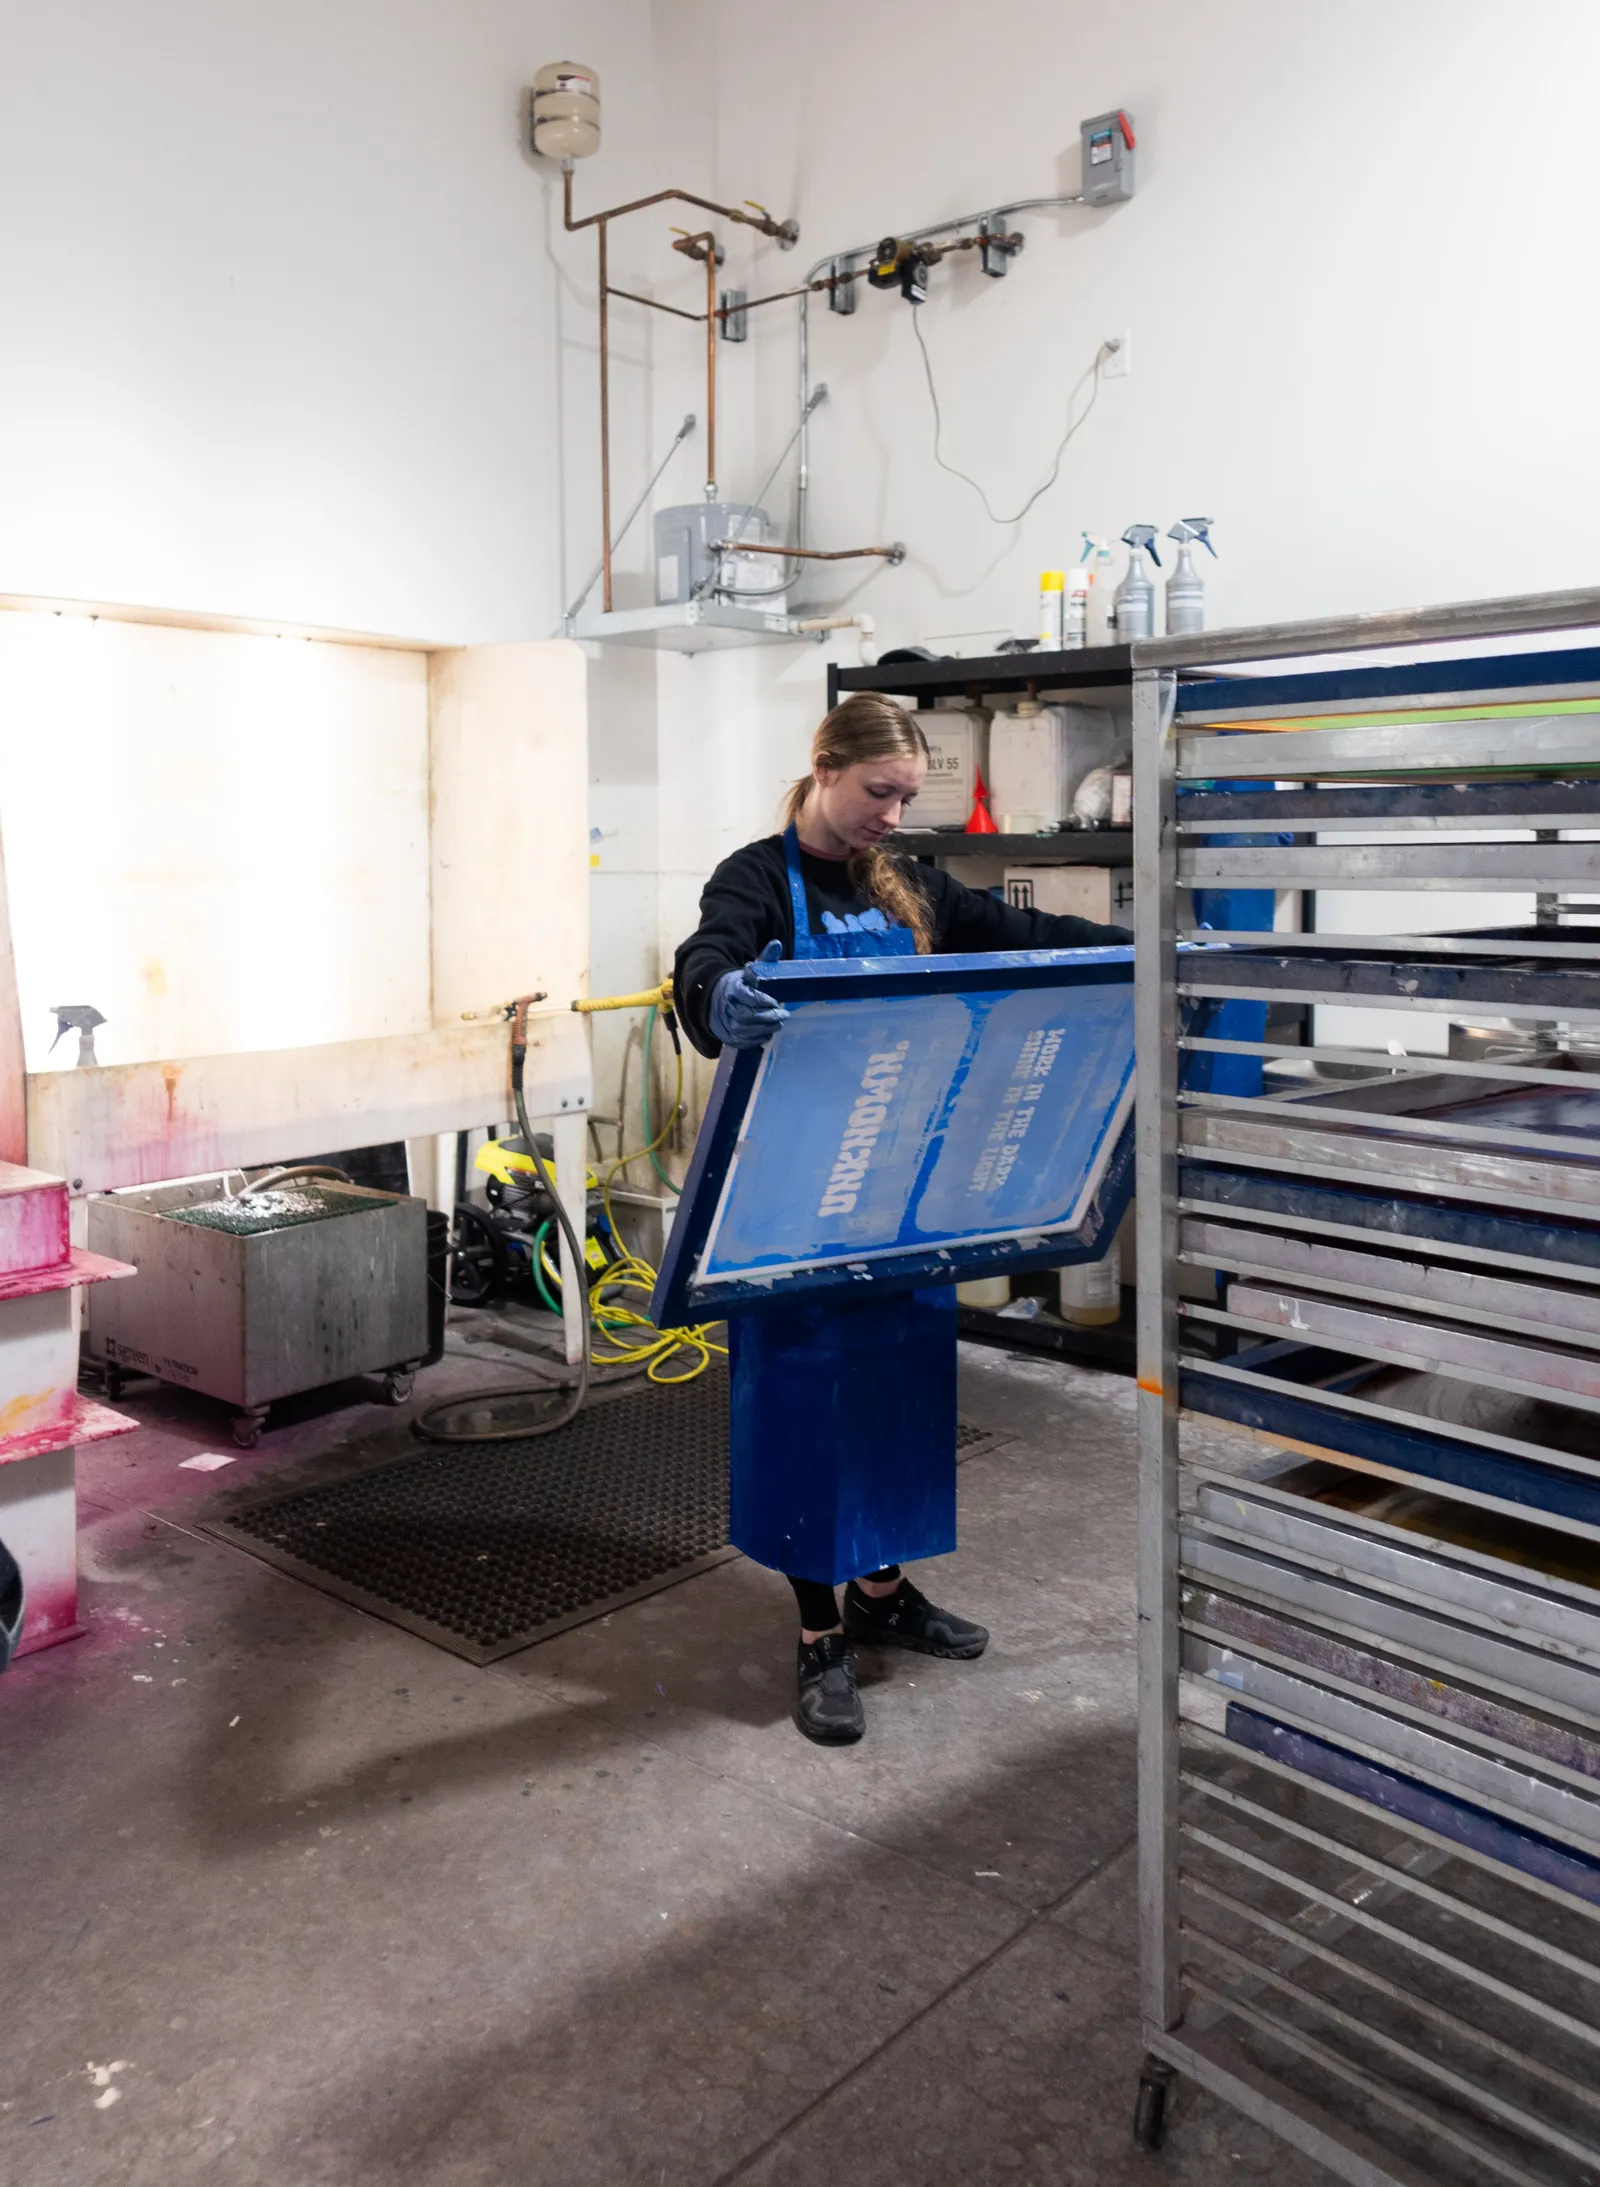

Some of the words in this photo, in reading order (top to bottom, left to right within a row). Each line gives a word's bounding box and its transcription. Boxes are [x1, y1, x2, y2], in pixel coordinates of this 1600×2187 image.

[946, 757, 960, 770] 55
[987, 1109, 1014, 1141] THE
[1008, 1106, 1036, 1139] THE
